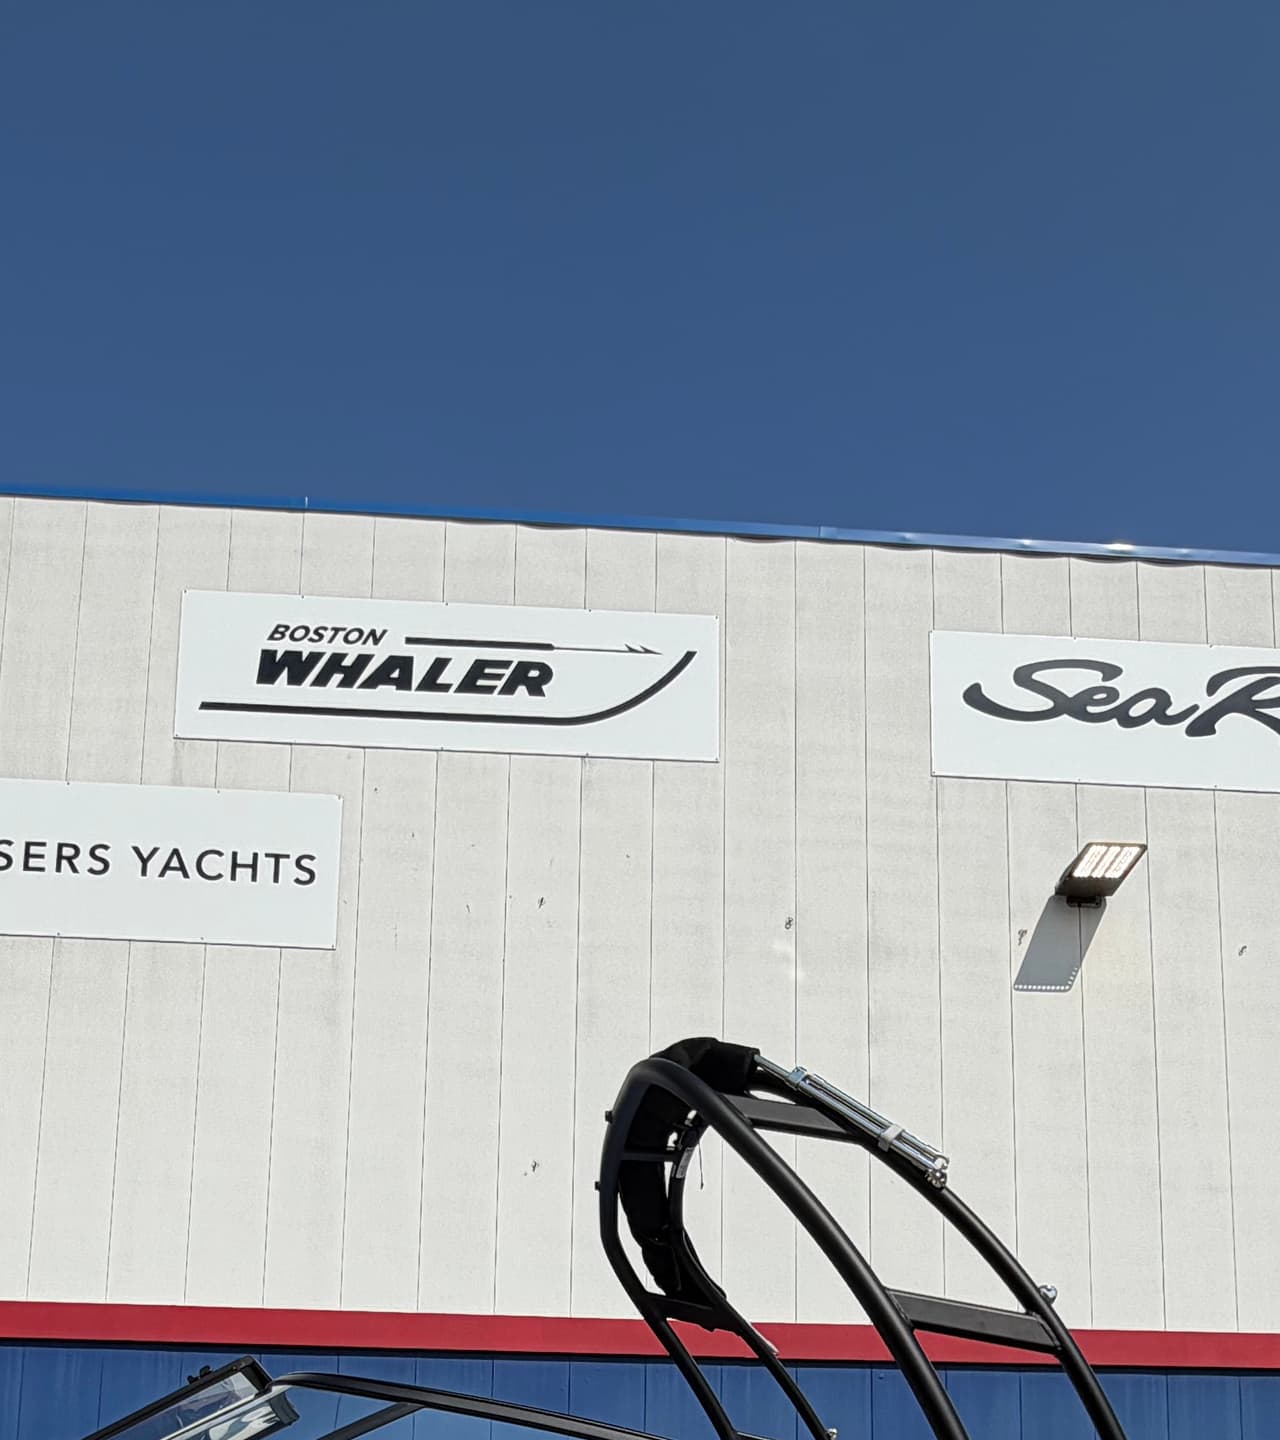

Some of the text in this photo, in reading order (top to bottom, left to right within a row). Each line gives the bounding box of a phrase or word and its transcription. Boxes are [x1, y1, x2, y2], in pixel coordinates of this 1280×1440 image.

[267, 623, 388, 646] BOSTON
[256, 648, 554, 697] WHALER
[962, 659, 1200, 729] Sea
[131, 845, 316, 886] YACHTS
